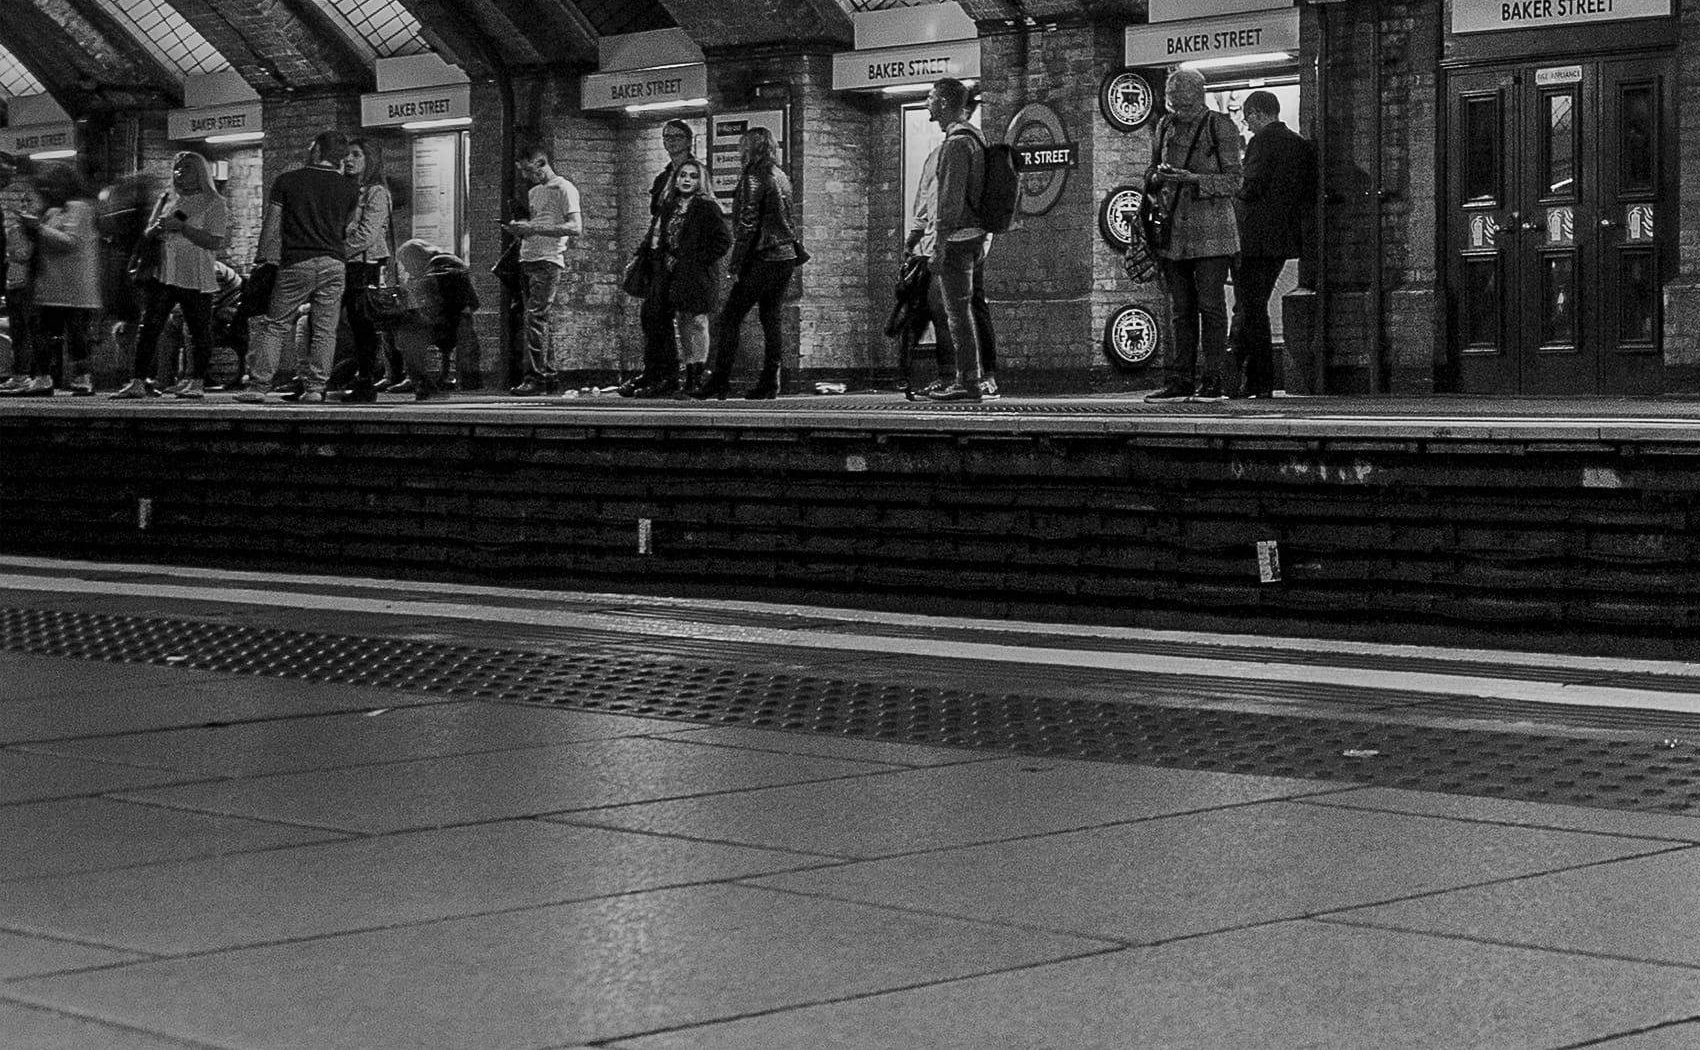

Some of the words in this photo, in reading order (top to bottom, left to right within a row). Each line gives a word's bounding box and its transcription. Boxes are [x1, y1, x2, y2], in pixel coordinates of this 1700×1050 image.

[1501, 0, 1552, 21] BAKER
[1166, 35, 1210, 54] BAKER
[1213, 28, 1262, 49] STREET
[868, 62, 905, 80] BAKER
[909, 57, 951, 76] STREET
[611, 83, 643, 99] BAKER
[646, 79, 682, 96] STREET
[387, 102, 416, 118] BAKER
[418, 99, 450, 116] STREET
[191, 117, 216, 132] BAKER
[218, 114, 246, 130] STREET
[1034, 149, 1070, 164] STREET
